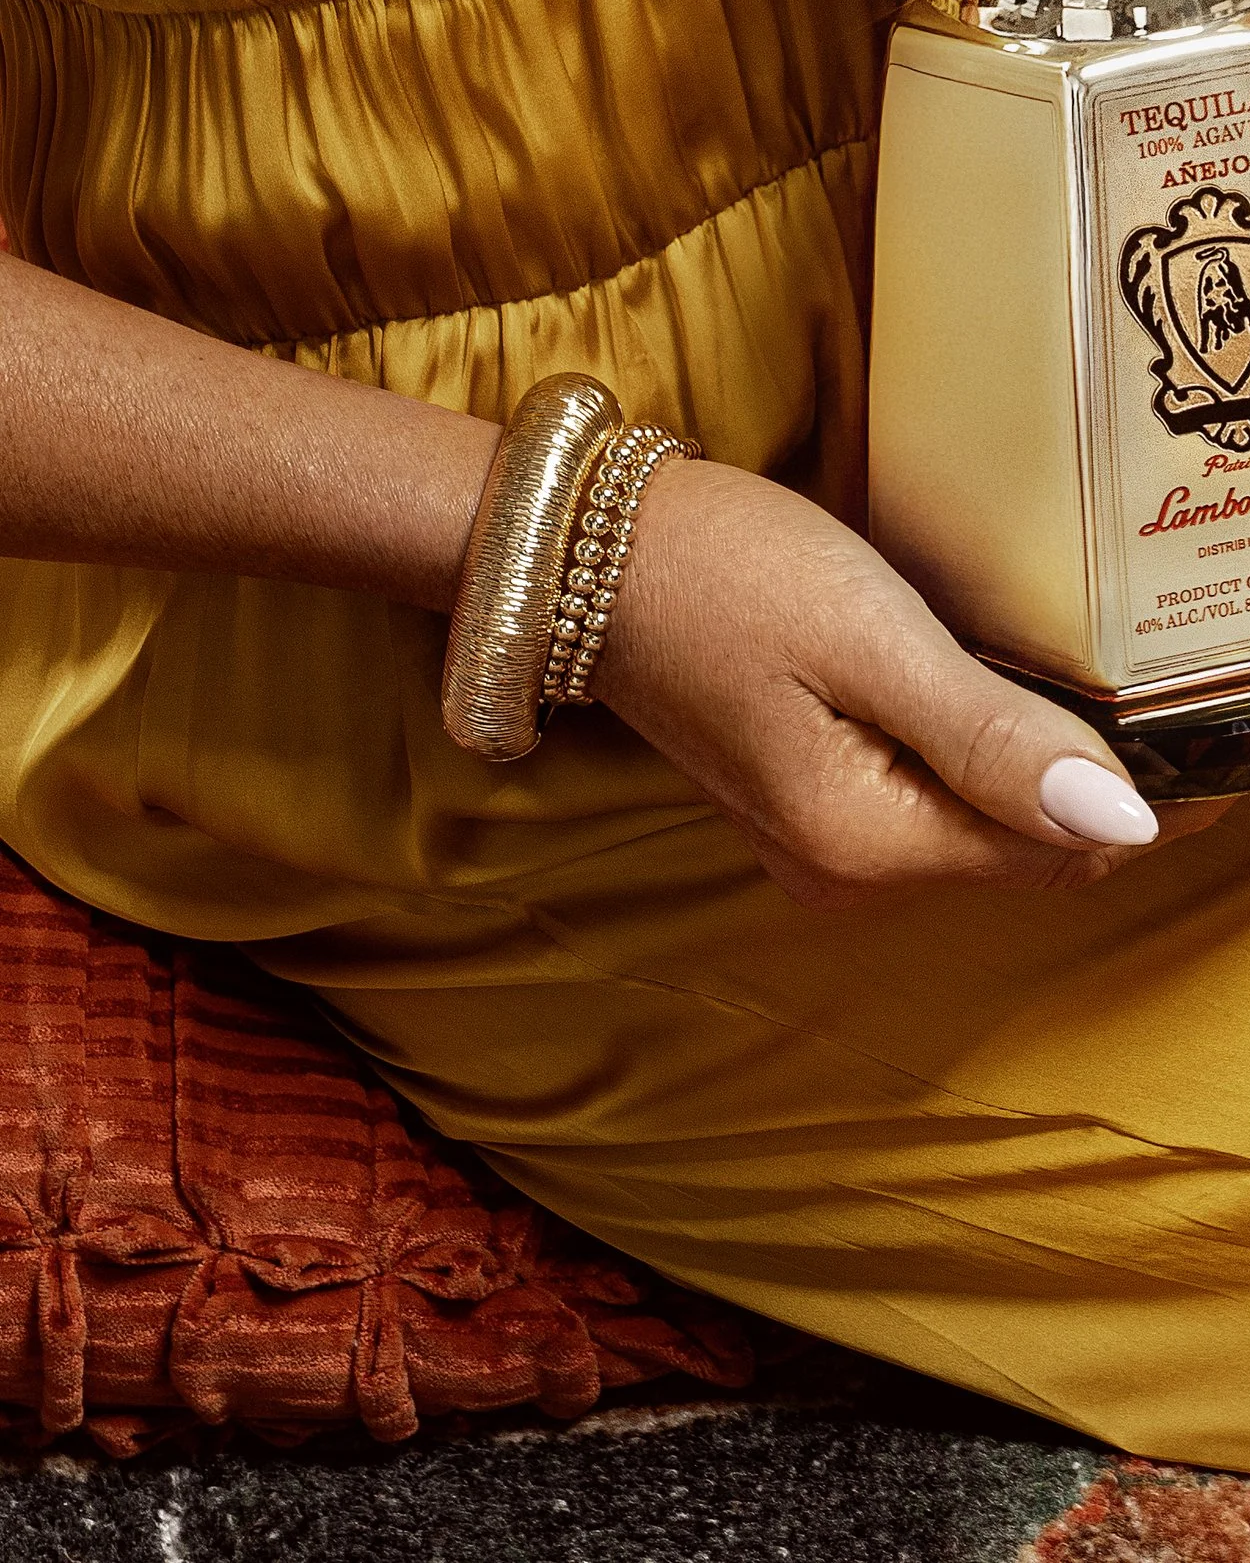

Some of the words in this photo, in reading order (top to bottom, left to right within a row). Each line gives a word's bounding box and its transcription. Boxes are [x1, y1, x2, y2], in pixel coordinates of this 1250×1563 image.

[1137, 135, 1184, 160] 100%
[1161, 154, 1250, 189] AÑEJO
[1156, 578, 1242, 609] PRODUCT
[1134, 616, 1163, 636] 40%
